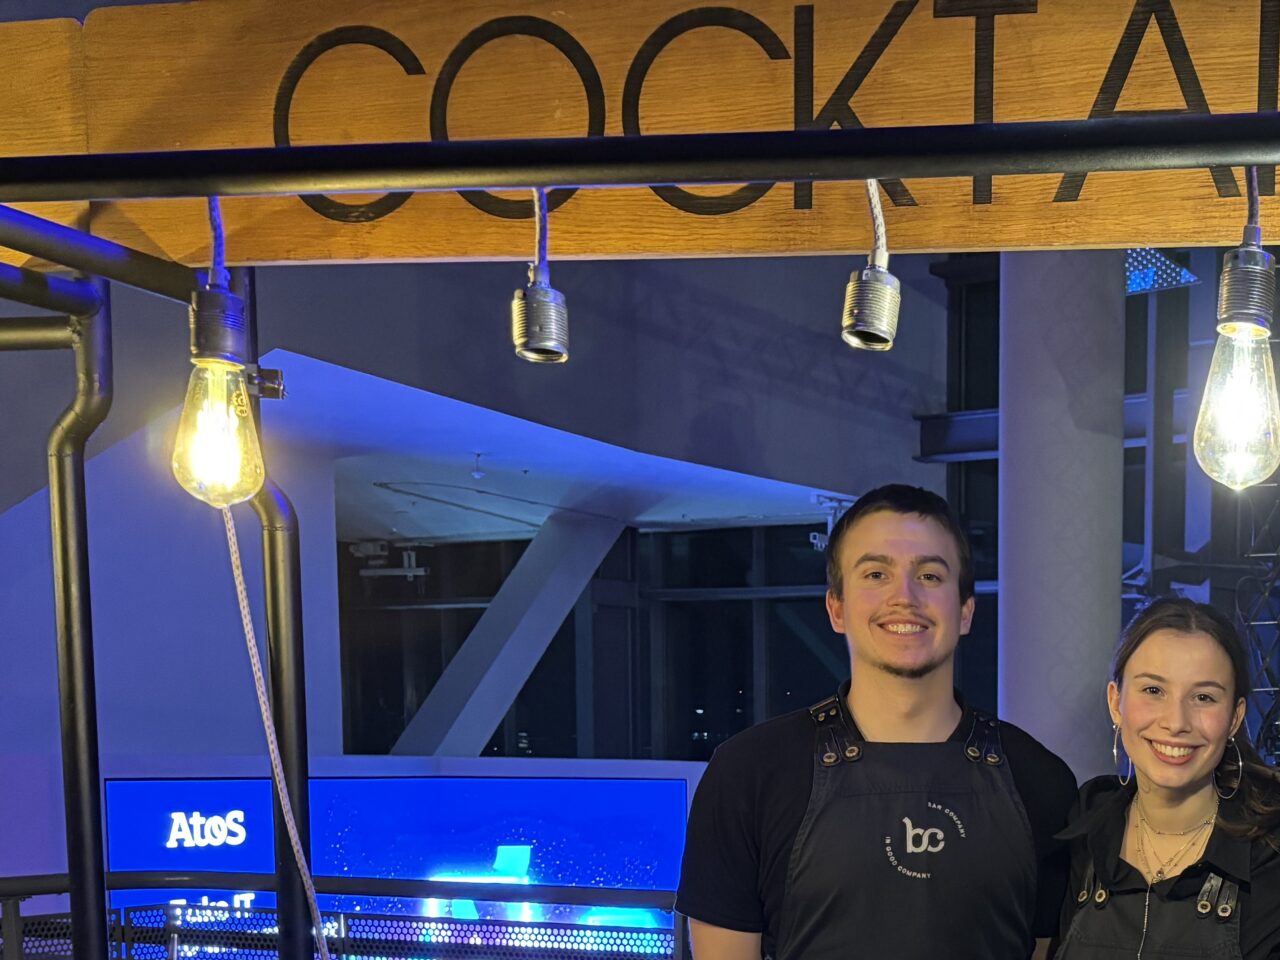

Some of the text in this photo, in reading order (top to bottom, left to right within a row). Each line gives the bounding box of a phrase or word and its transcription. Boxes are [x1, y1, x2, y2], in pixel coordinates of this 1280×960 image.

[166, 810, 246, 848] Atos
[944, 808, 966, 838] COMPANY
[898, 866, 931, 878] COMPANY
